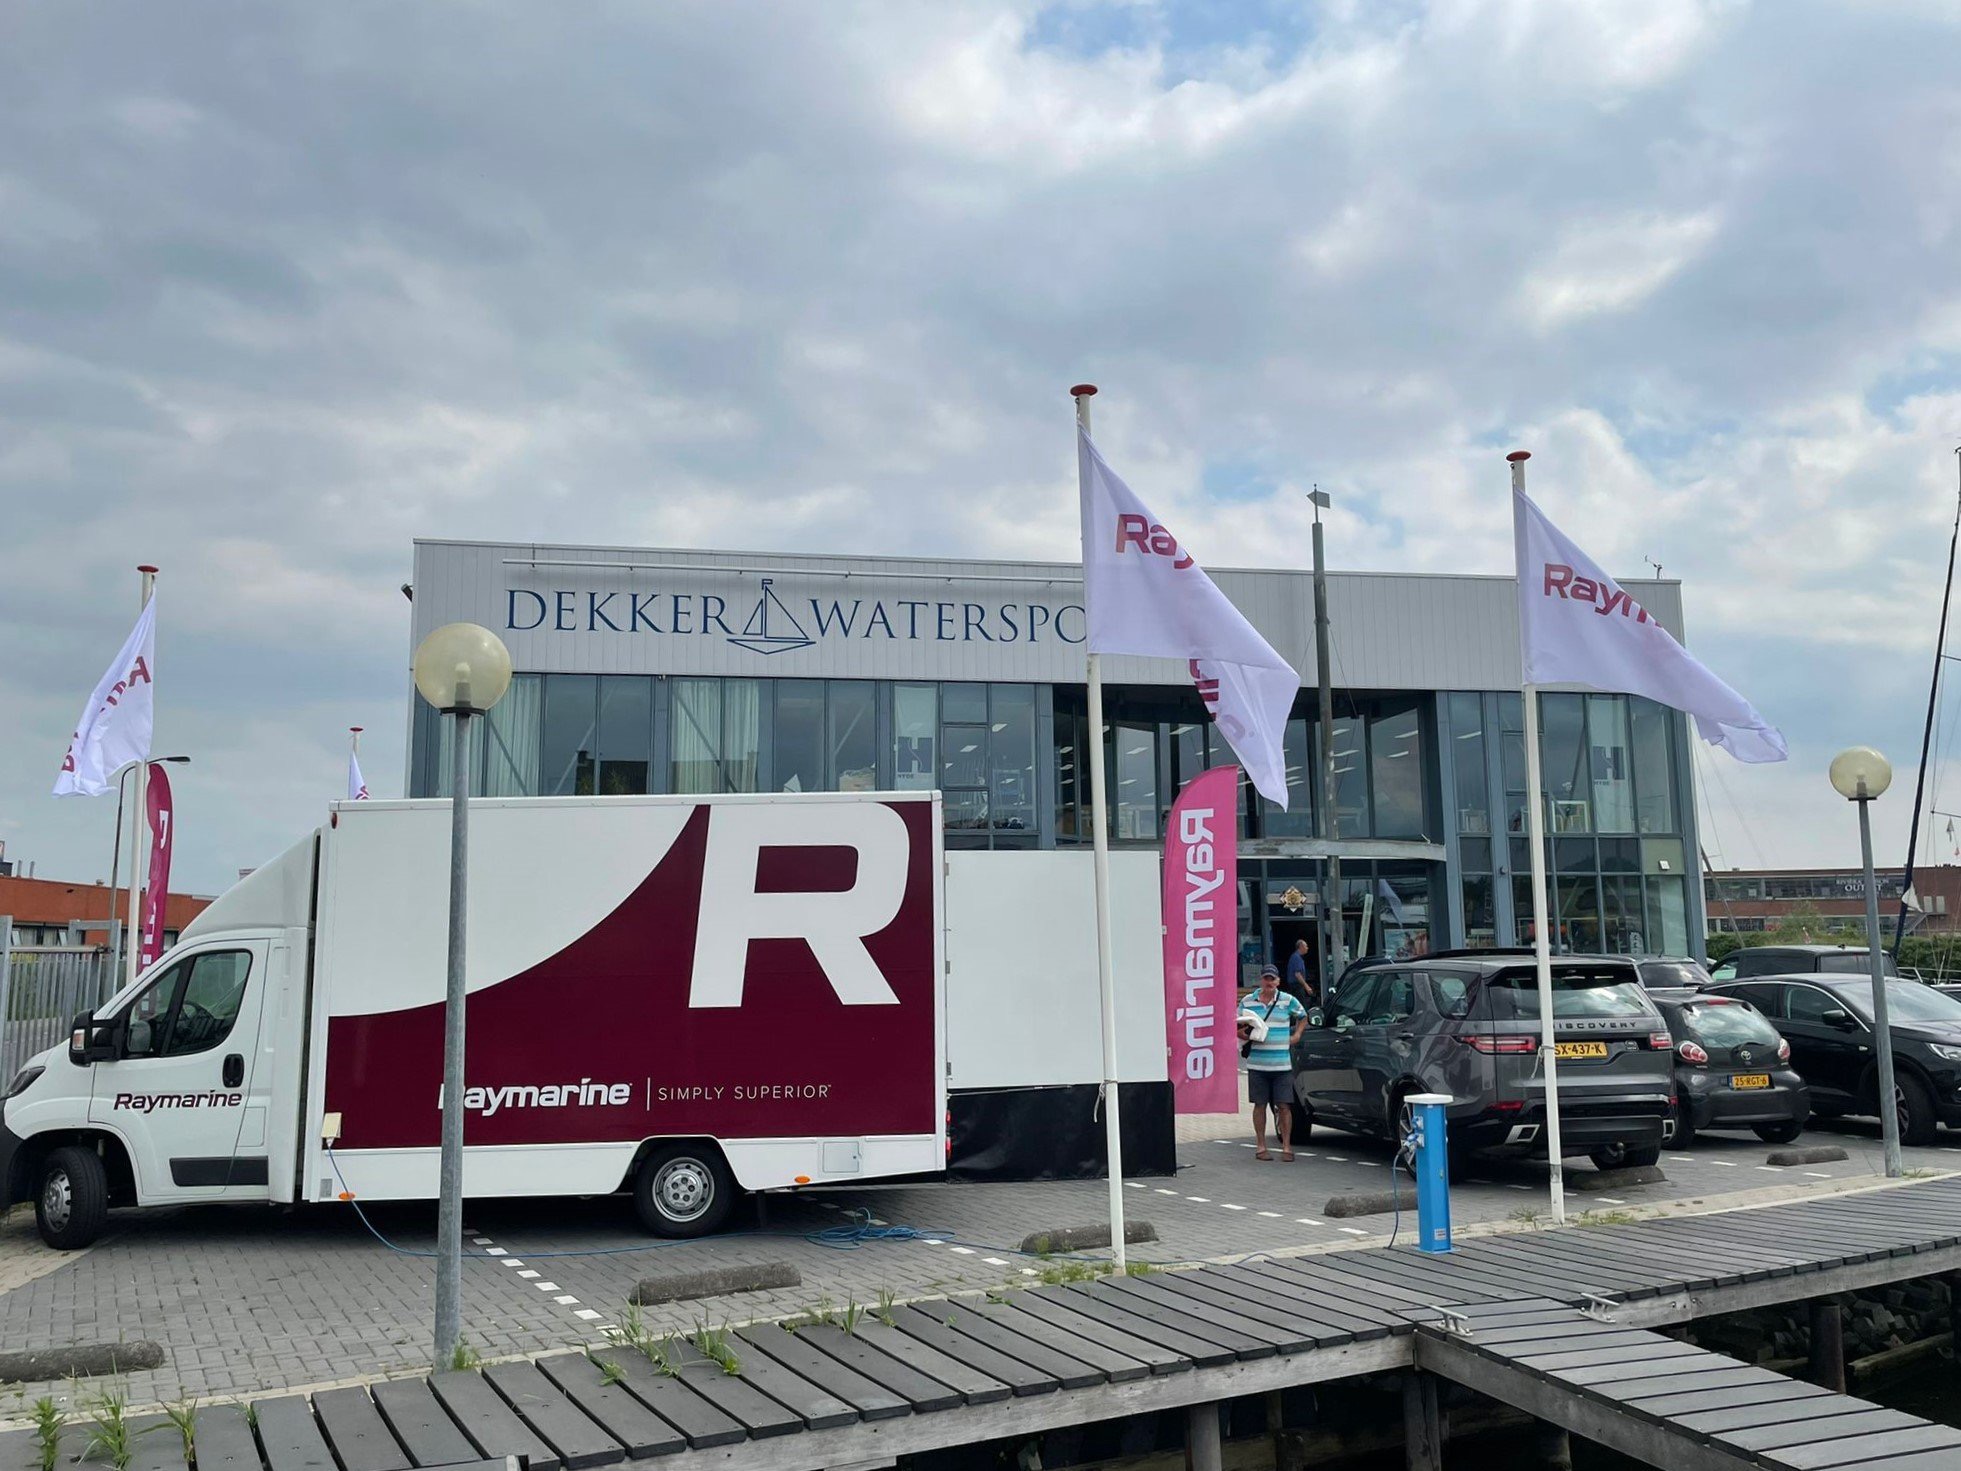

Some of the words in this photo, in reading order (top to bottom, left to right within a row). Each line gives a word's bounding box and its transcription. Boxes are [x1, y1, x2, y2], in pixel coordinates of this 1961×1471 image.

[505, 589, 736, 635] DEKKER
[807, 598, 1087, 644] WATERSPO
[689, 802, 911, 1008] R
[1553, 1021, 1637, 1030] ISCOVERY
[437, 1077, 632, 1117] aymarine
[658, 1086, 724, 1101] SIMPLY
[1735, 1076, 1767, 1086] 25-RGT-6
[113, 1089, 243, 1114] Raymarine
